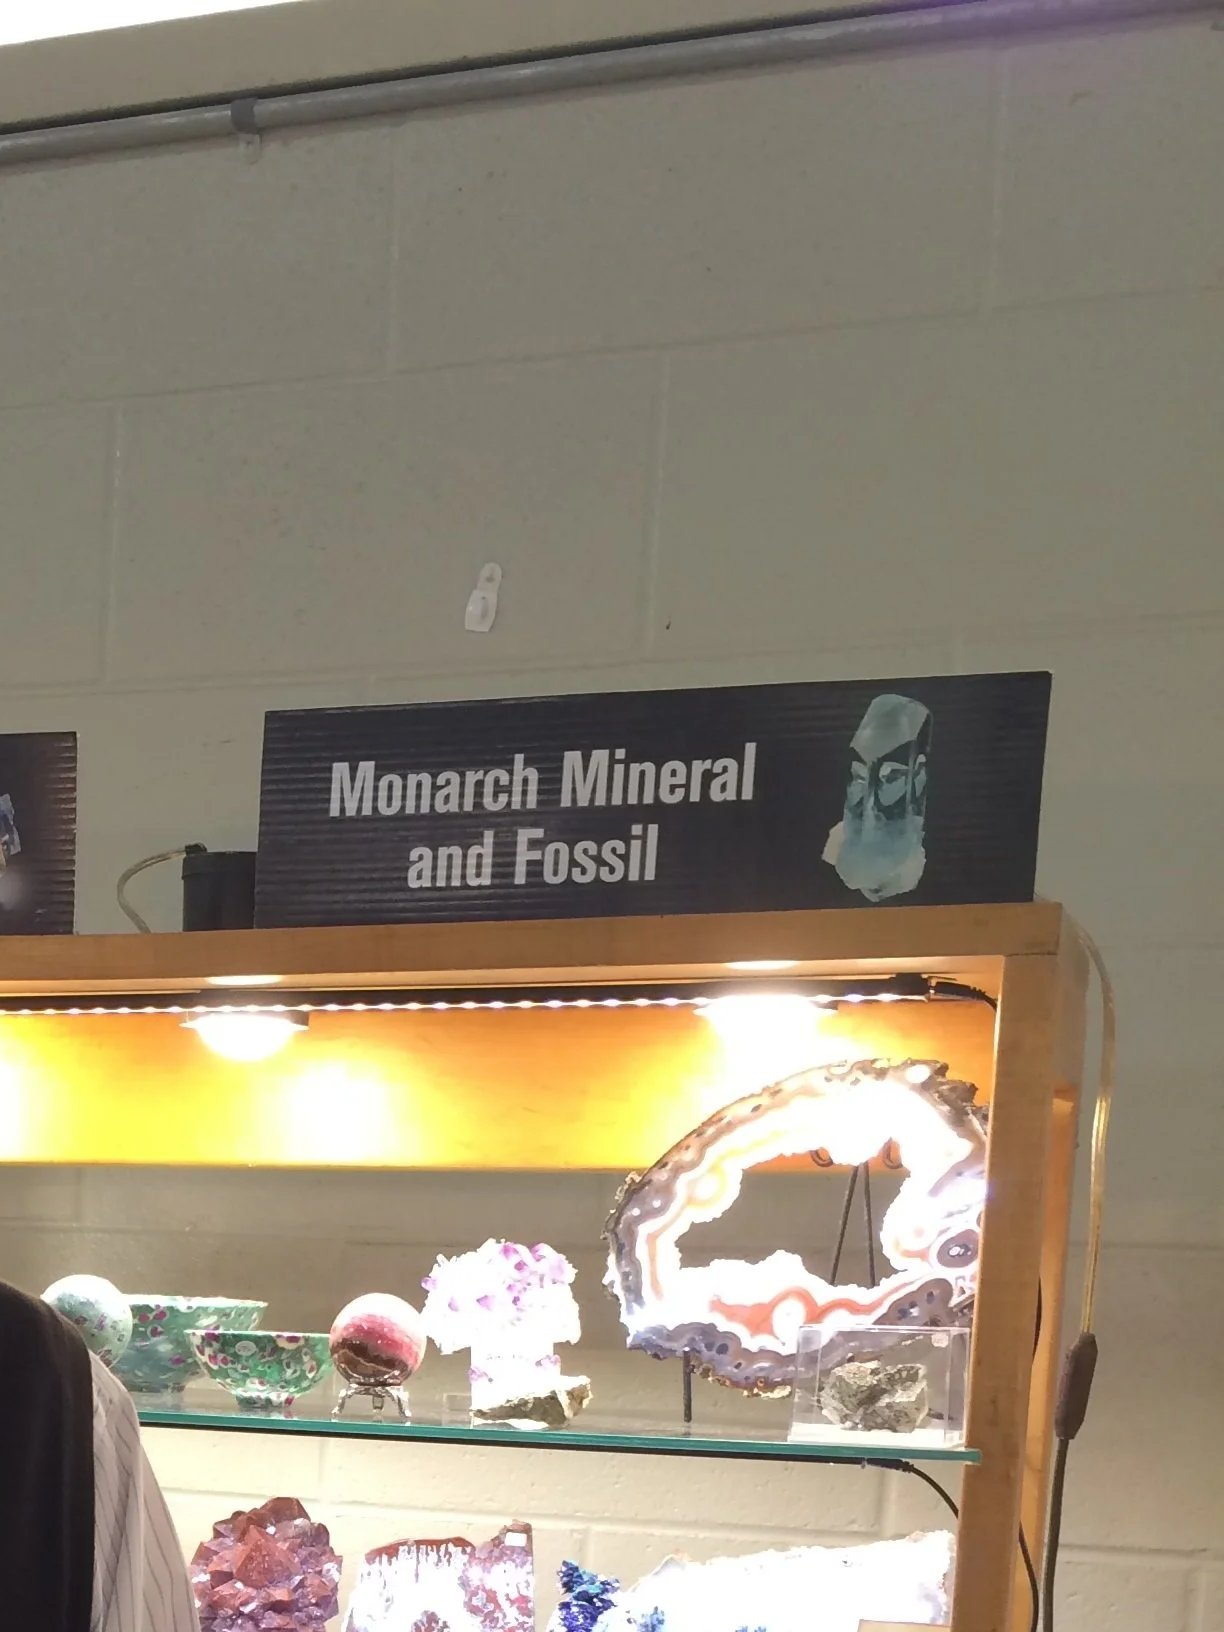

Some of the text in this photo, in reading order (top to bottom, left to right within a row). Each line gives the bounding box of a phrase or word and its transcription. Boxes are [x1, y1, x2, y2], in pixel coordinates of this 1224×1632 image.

[330, 743, 756, 816] Monarch Mineral
[408, 824, 658, 888] and Fossil
